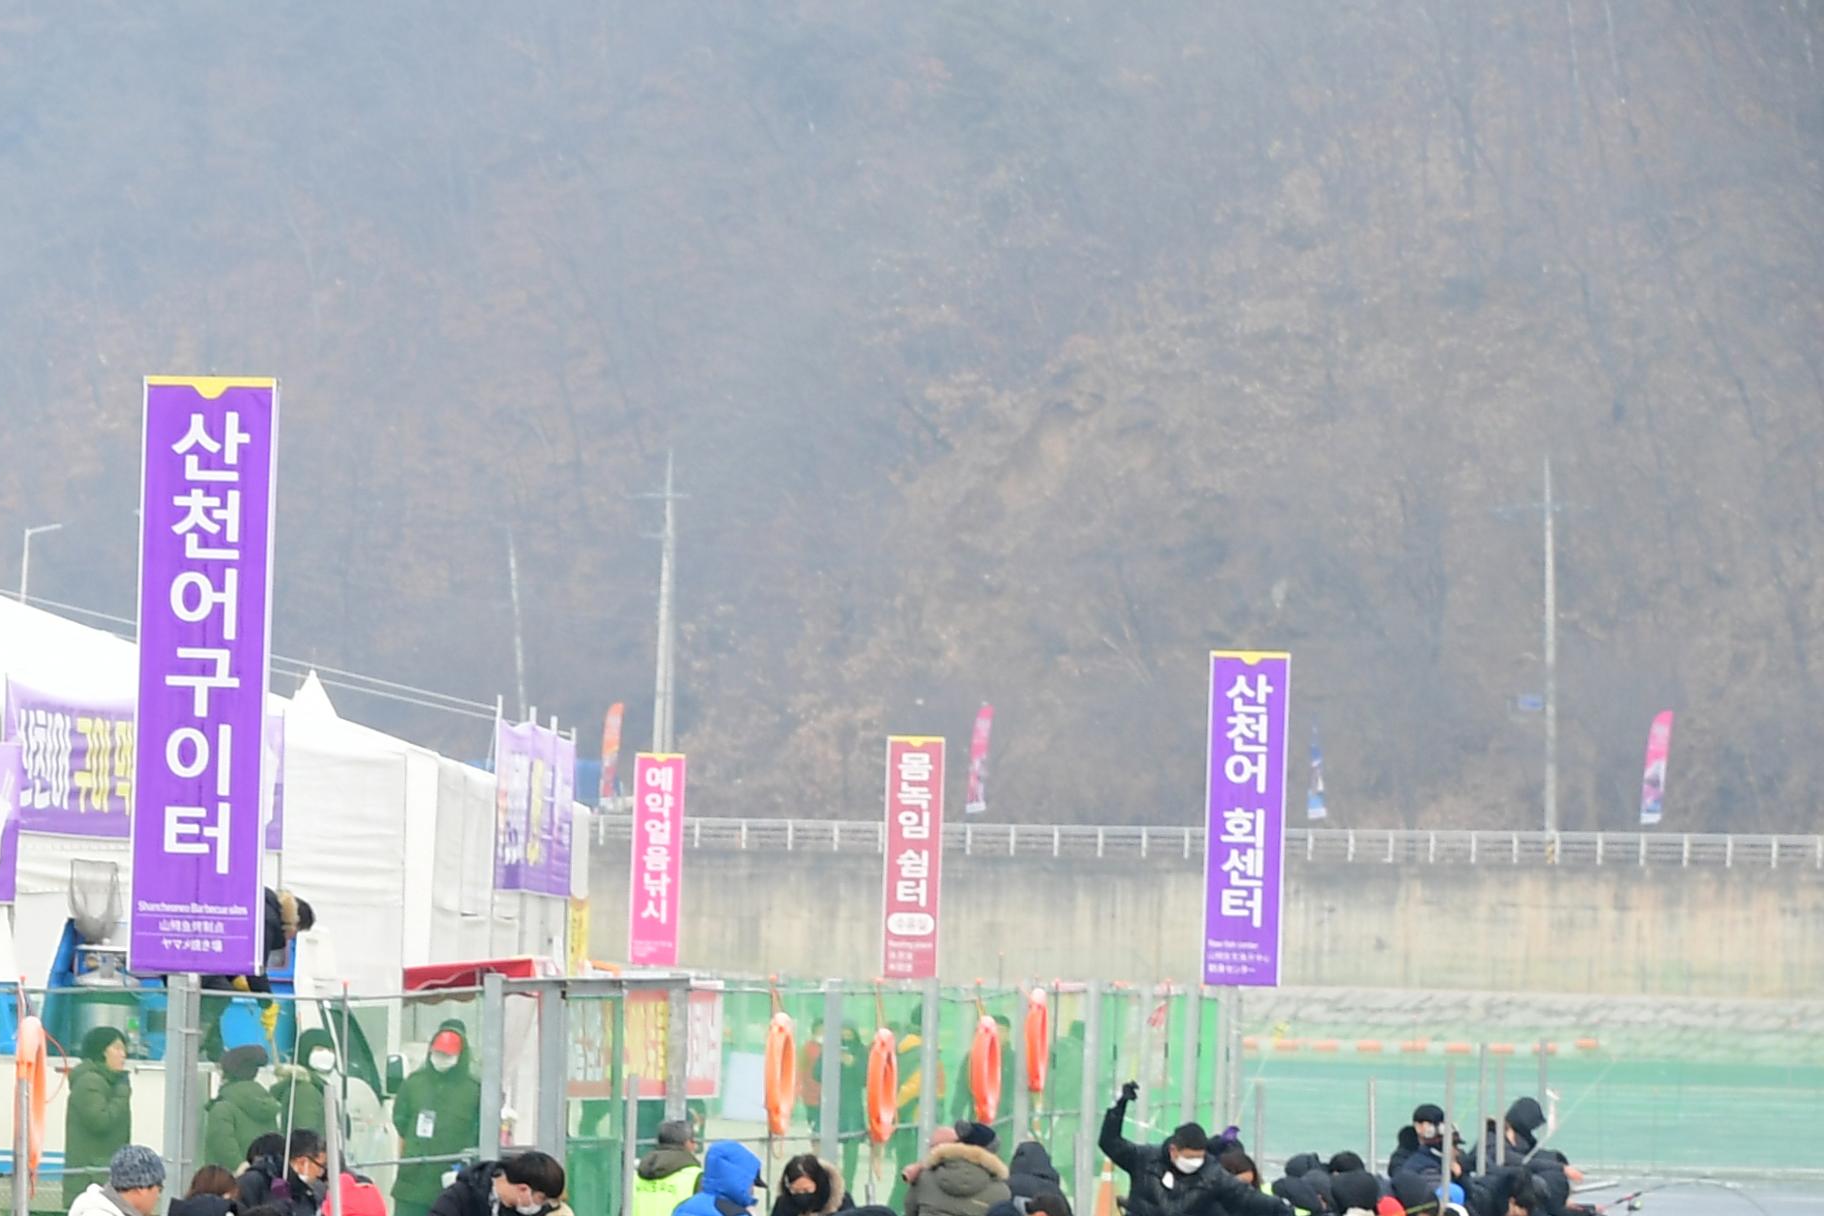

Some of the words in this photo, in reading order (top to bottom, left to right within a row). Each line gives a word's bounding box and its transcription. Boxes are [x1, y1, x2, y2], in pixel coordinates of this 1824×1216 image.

[163, 411, 250, 875] 산천어구이터
[1224, 673, 1273, 794] 산천어
[895, 849, 928, 908] 쉼터
[1220, 807, 1265, 928] 회센터
